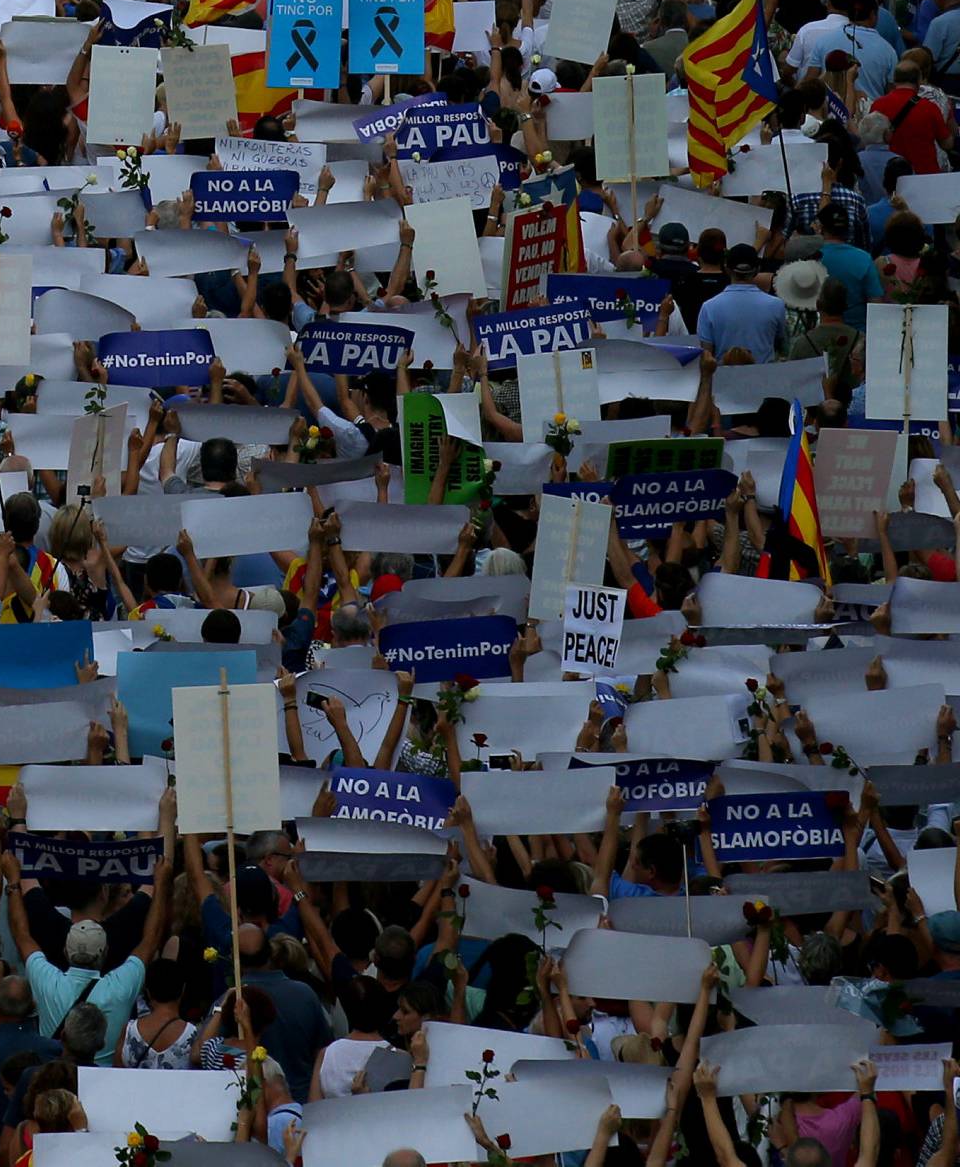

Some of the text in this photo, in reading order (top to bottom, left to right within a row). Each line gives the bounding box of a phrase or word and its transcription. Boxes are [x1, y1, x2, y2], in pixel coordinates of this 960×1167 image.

[276, 4, 333, 16] TINC POR
[406, 112, 481, 125] MILLOR RESPOS
[435, 123, 490, 148] PAU
[231, 152, 246, 162] NI
[252, 153, 308, 168] GUERRAS
[237, 140, 313, 157] FRONTERAS
[207, 179, 275, 193] NO A LA
[521, 217, 557, 240] VOLEM
[541, 238, 556, 256] NO
[515, 260, 555, 285] VENDRE
[479, 309, 592, 335] LA MILLOR RESPOSTA
[312, 329, 351, 342] MILLOR
[353, 332, 407, 345] RESPOSTA
[482, 332, 523, 361] LA
[101, 351, 213, 368] #NoTenimPor
[341, 344, 407, 370] PAU
[409, 421, 425, 475] IMAGINE
[631, 478, 706, 495] NO A LA
[614, 493, 727, 519] SLAMOFÒBIA
[572, 589, 619, 624] JUST
[384, 641, 511, 664] #NoTenimPor
[563, 631, 619, 670] PEACE!
[636, 761, 681, 777] A LA
[337, 777, 421, 803] NO A LA
[620, 779, 708, 800] MOFÒBIA
[726, 802, 813, 821] NO A LA
[15, 838, 156, 857] LA MILLOR RESPOSTA
[711, 825, 845, 850] SLAMOFÒBIA
[15, 848, 157, 878] LA PAU
